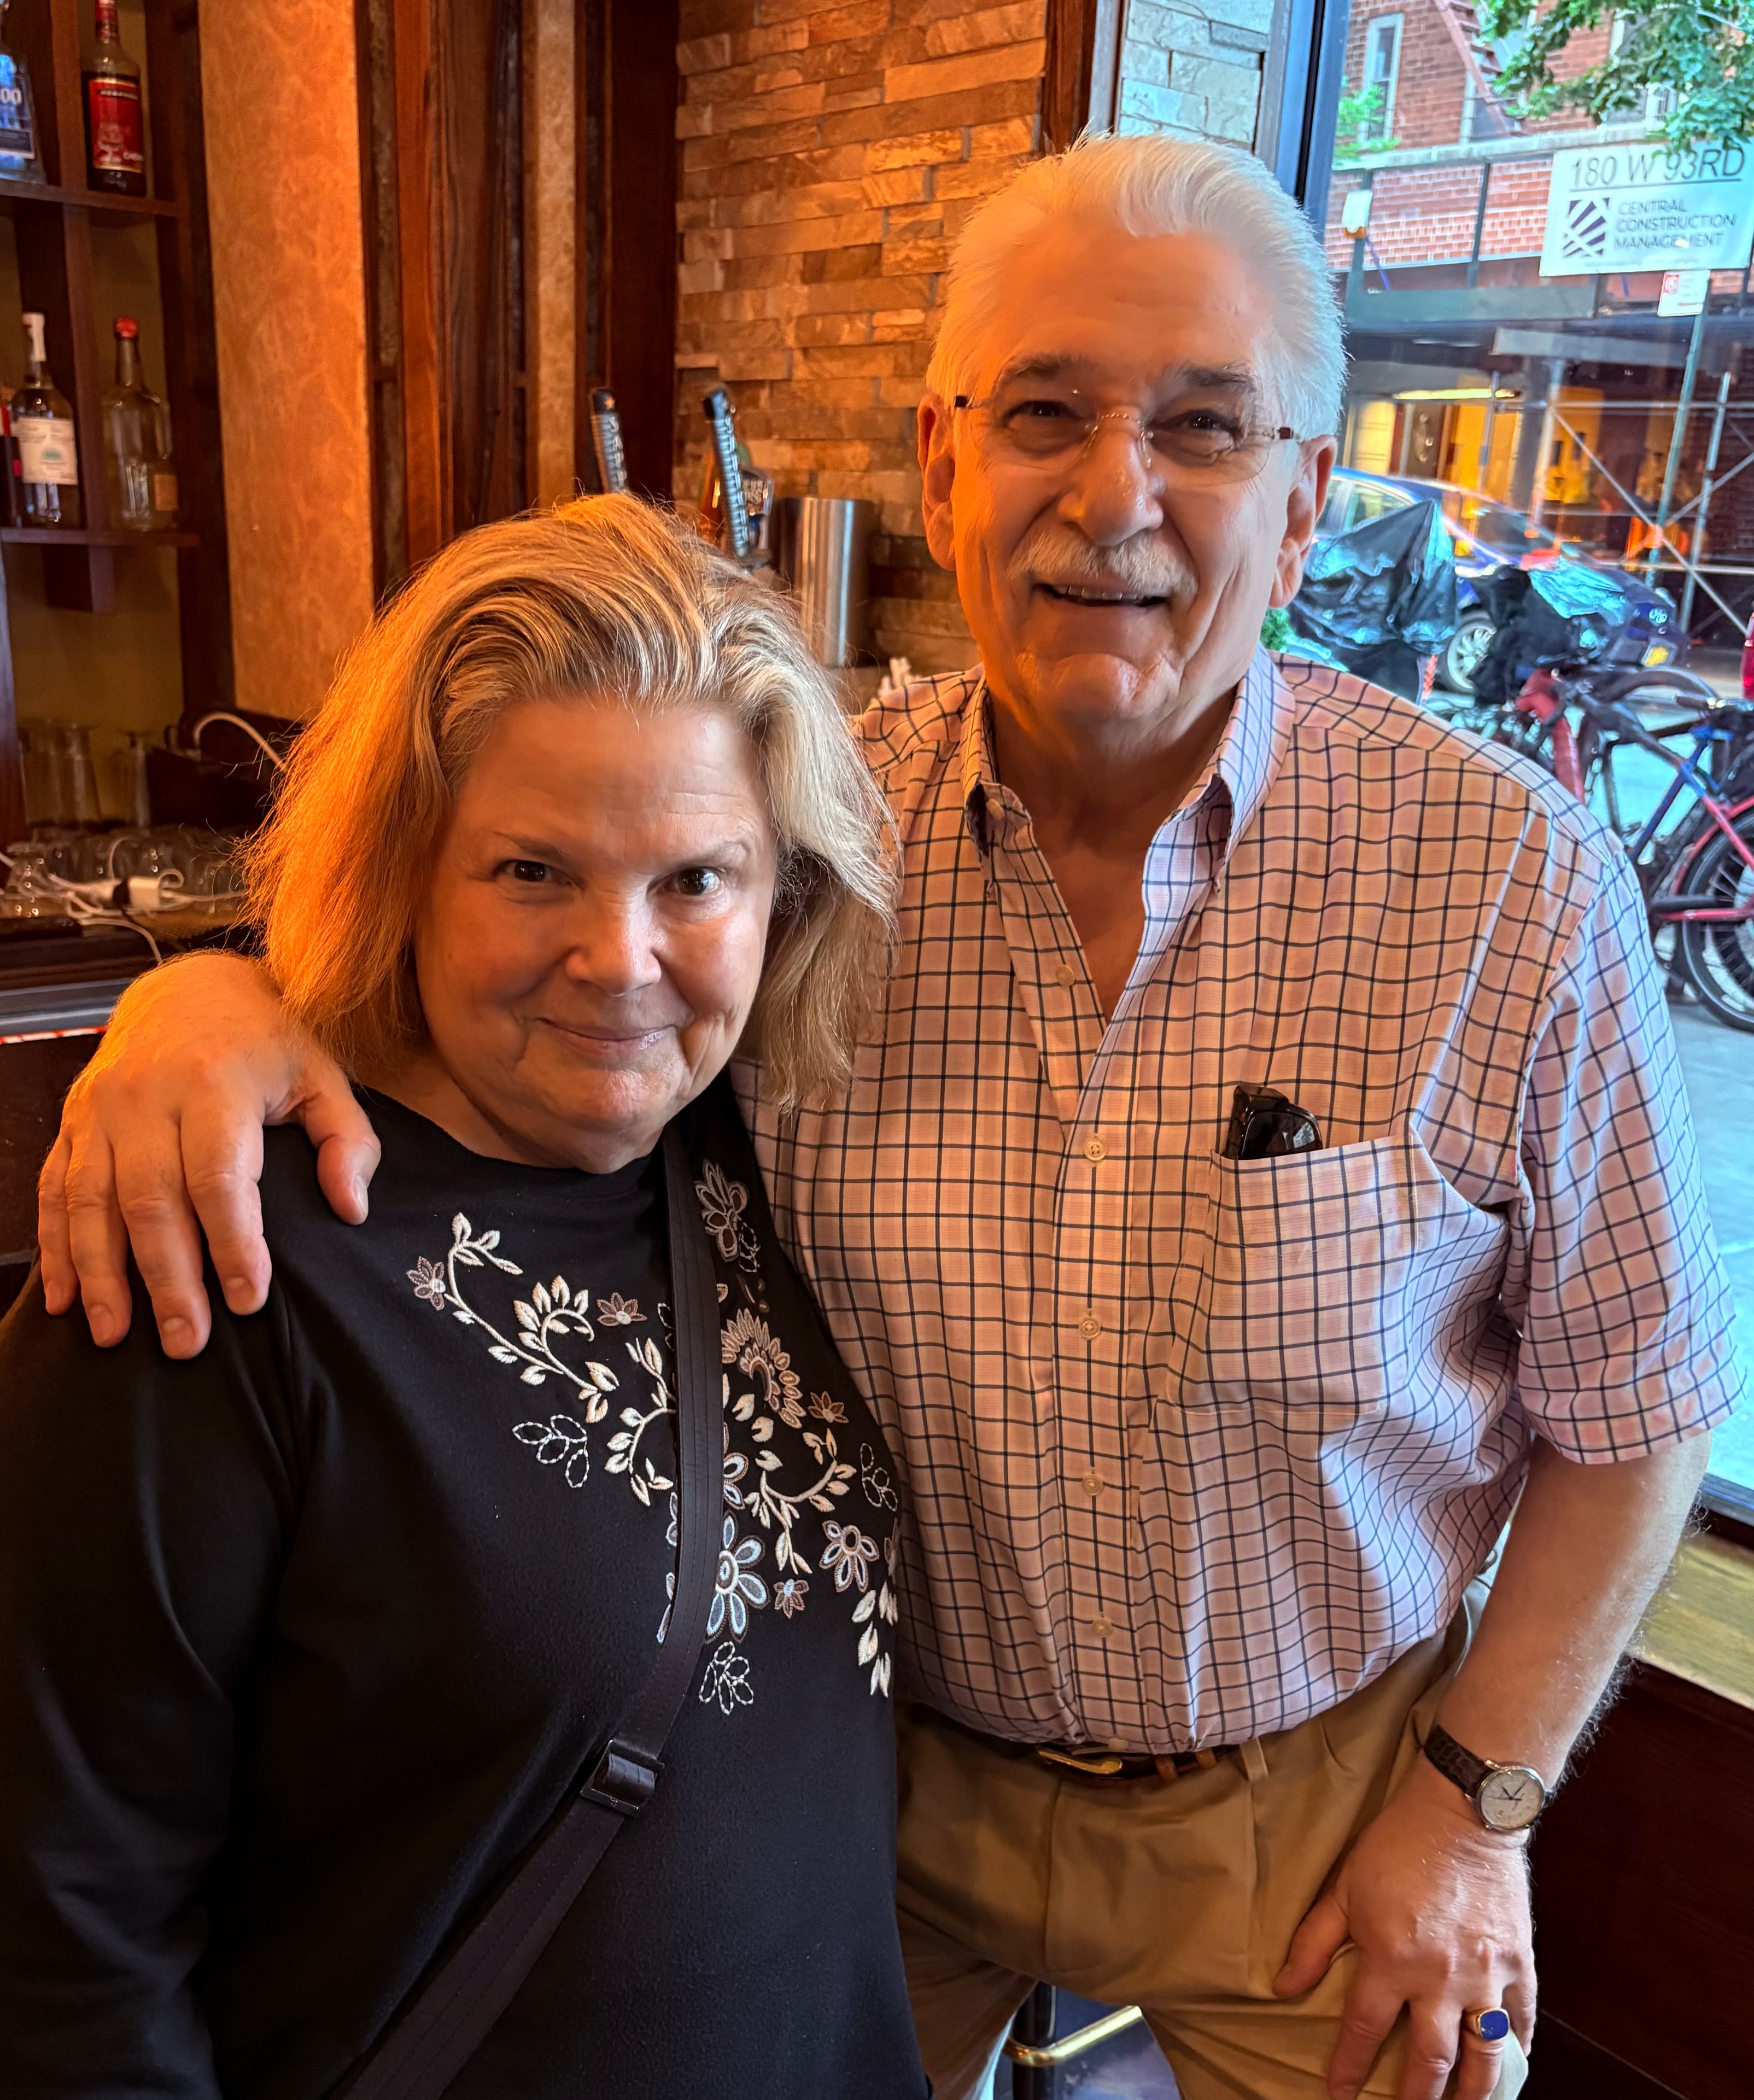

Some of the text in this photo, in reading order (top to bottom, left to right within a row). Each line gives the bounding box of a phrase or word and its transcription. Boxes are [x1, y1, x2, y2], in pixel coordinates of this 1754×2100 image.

[1573, 148, 1745, 187] 180 W 93RD
[1618, 200, 1687, 214] CENTRAL
[1616, 214, 1736, 231] CONSTRUCTION
